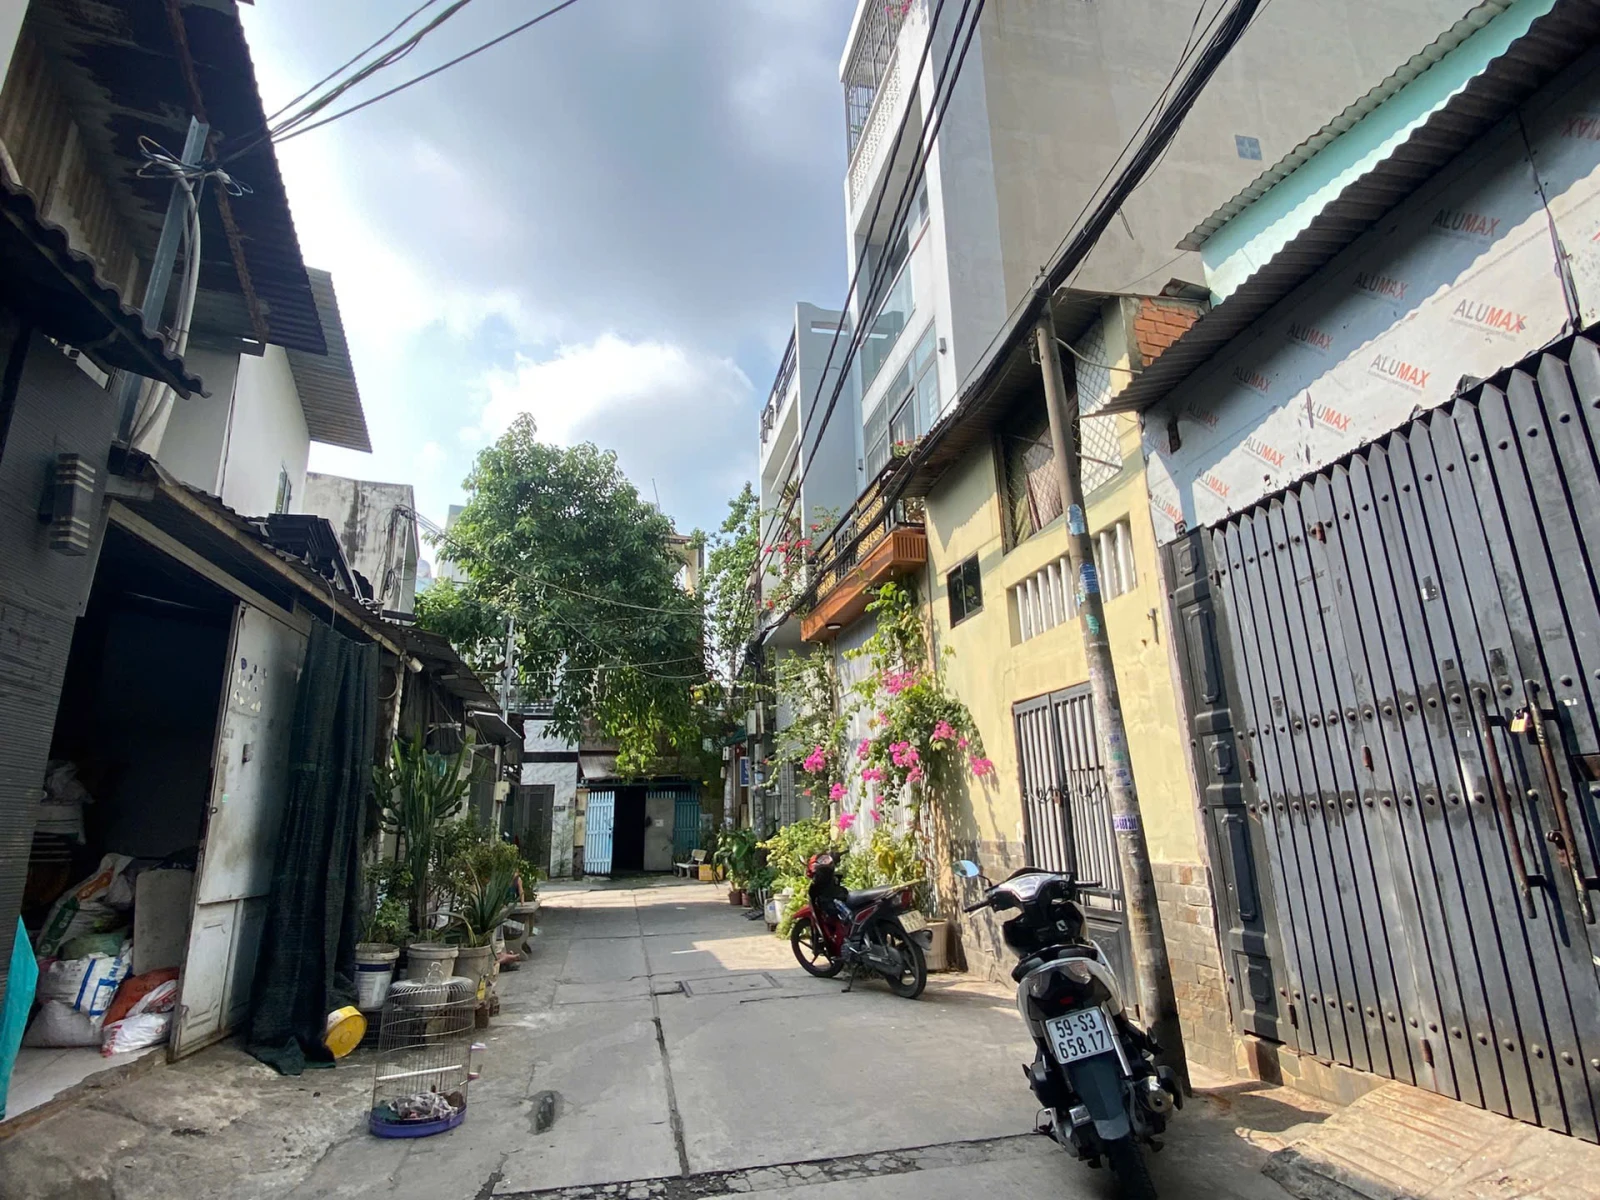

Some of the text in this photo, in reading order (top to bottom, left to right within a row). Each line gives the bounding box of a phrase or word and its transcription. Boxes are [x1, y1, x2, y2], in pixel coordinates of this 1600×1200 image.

[1431, 208, 1500, 237] ALUMAX
[1353, 271, 1409, 299] ALUMAX
[1453, 299, 1528, 334] ALUMAX
[1286, 322, 1334, 349] ALUMAX
[1232, 366, 1272, 393] ALUMAX
[1370, 353, 1431, 389] ALUMAX
[1243, 436, 1286, 468] ALUMAX
[1195, 468, 1231, 498] ALUMAX
[1152, 495, 1184, 524] ALUMAX
[1055, 1013, 1096, 1038] 59-S3
[1058, 1030, 1104, 1059] 658.17
